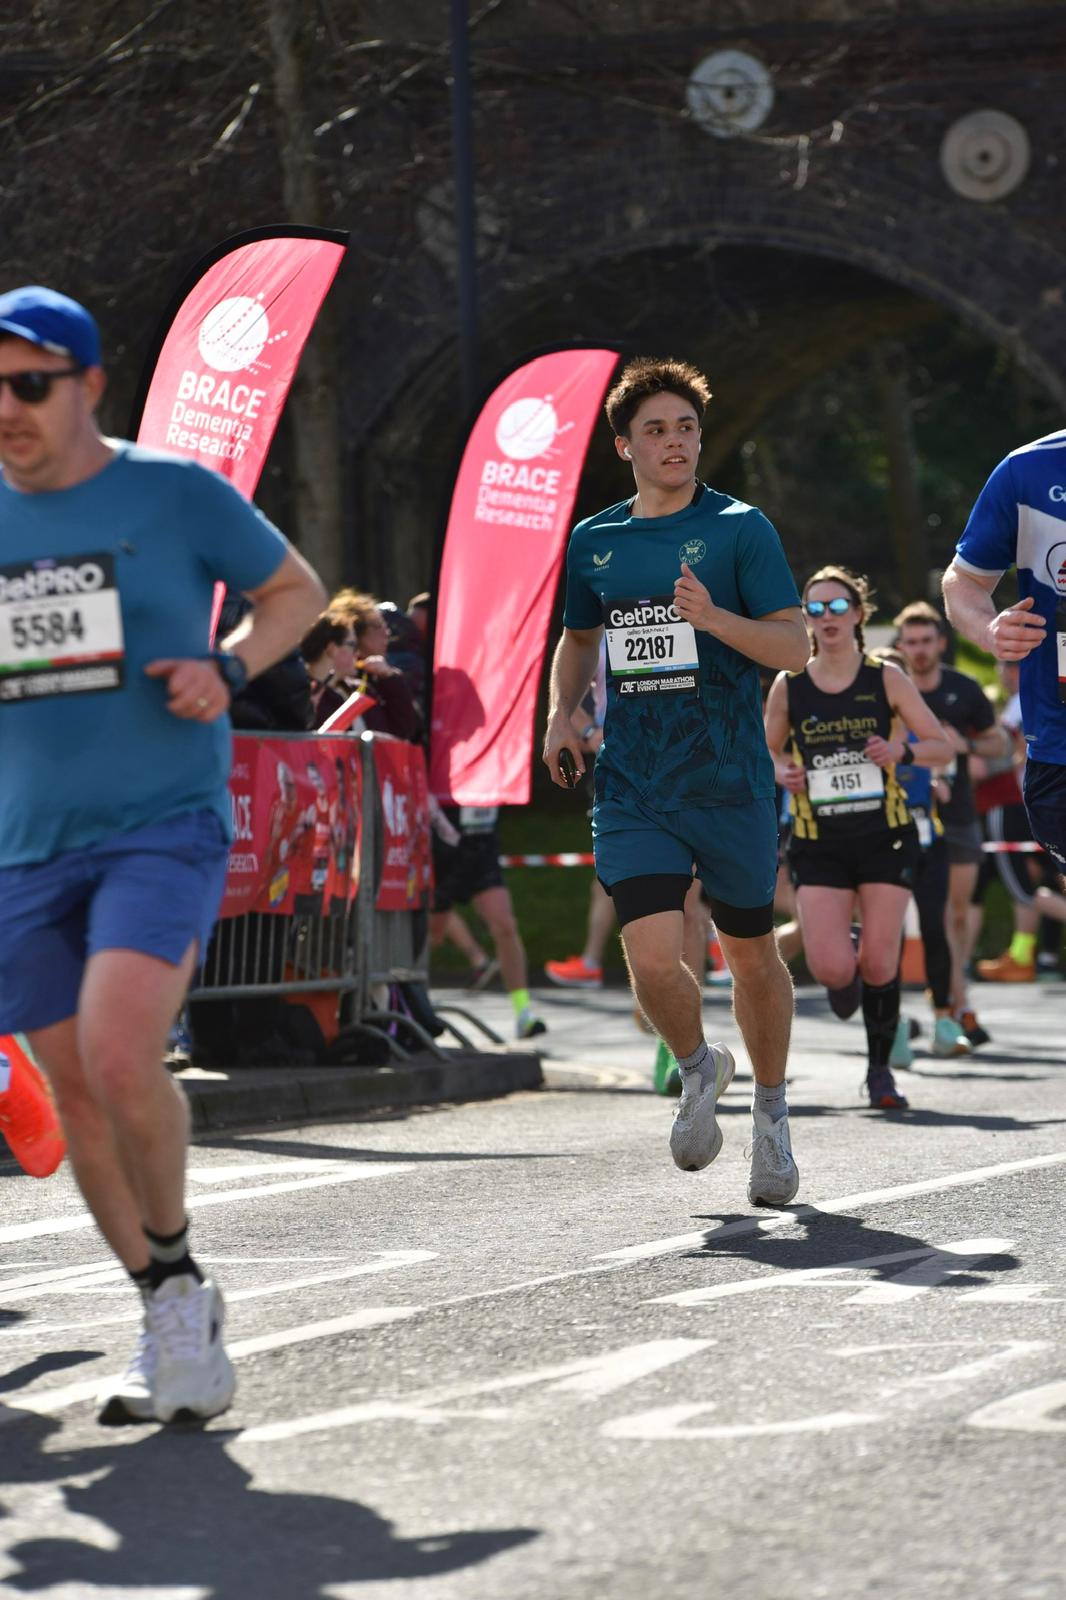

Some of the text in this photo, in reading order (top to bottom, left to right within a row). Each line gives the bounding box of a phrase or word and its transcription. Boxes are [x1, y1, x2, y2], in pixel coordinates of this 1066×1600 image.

[176, 370, 266, 418] BRACE
[170, 401, 253, 441] Dementia
[165, 423, 246, 461] Research
[482, 460, 561, 494] BRACE
[10, 609, 84, 650] 5584
[624, 635, 675, 662] 22187
[637, 675, 695, 687] LONDON MARATHON
[801, 716, 877, 735] Corsham
[830, 773, 862, 791] 4151
